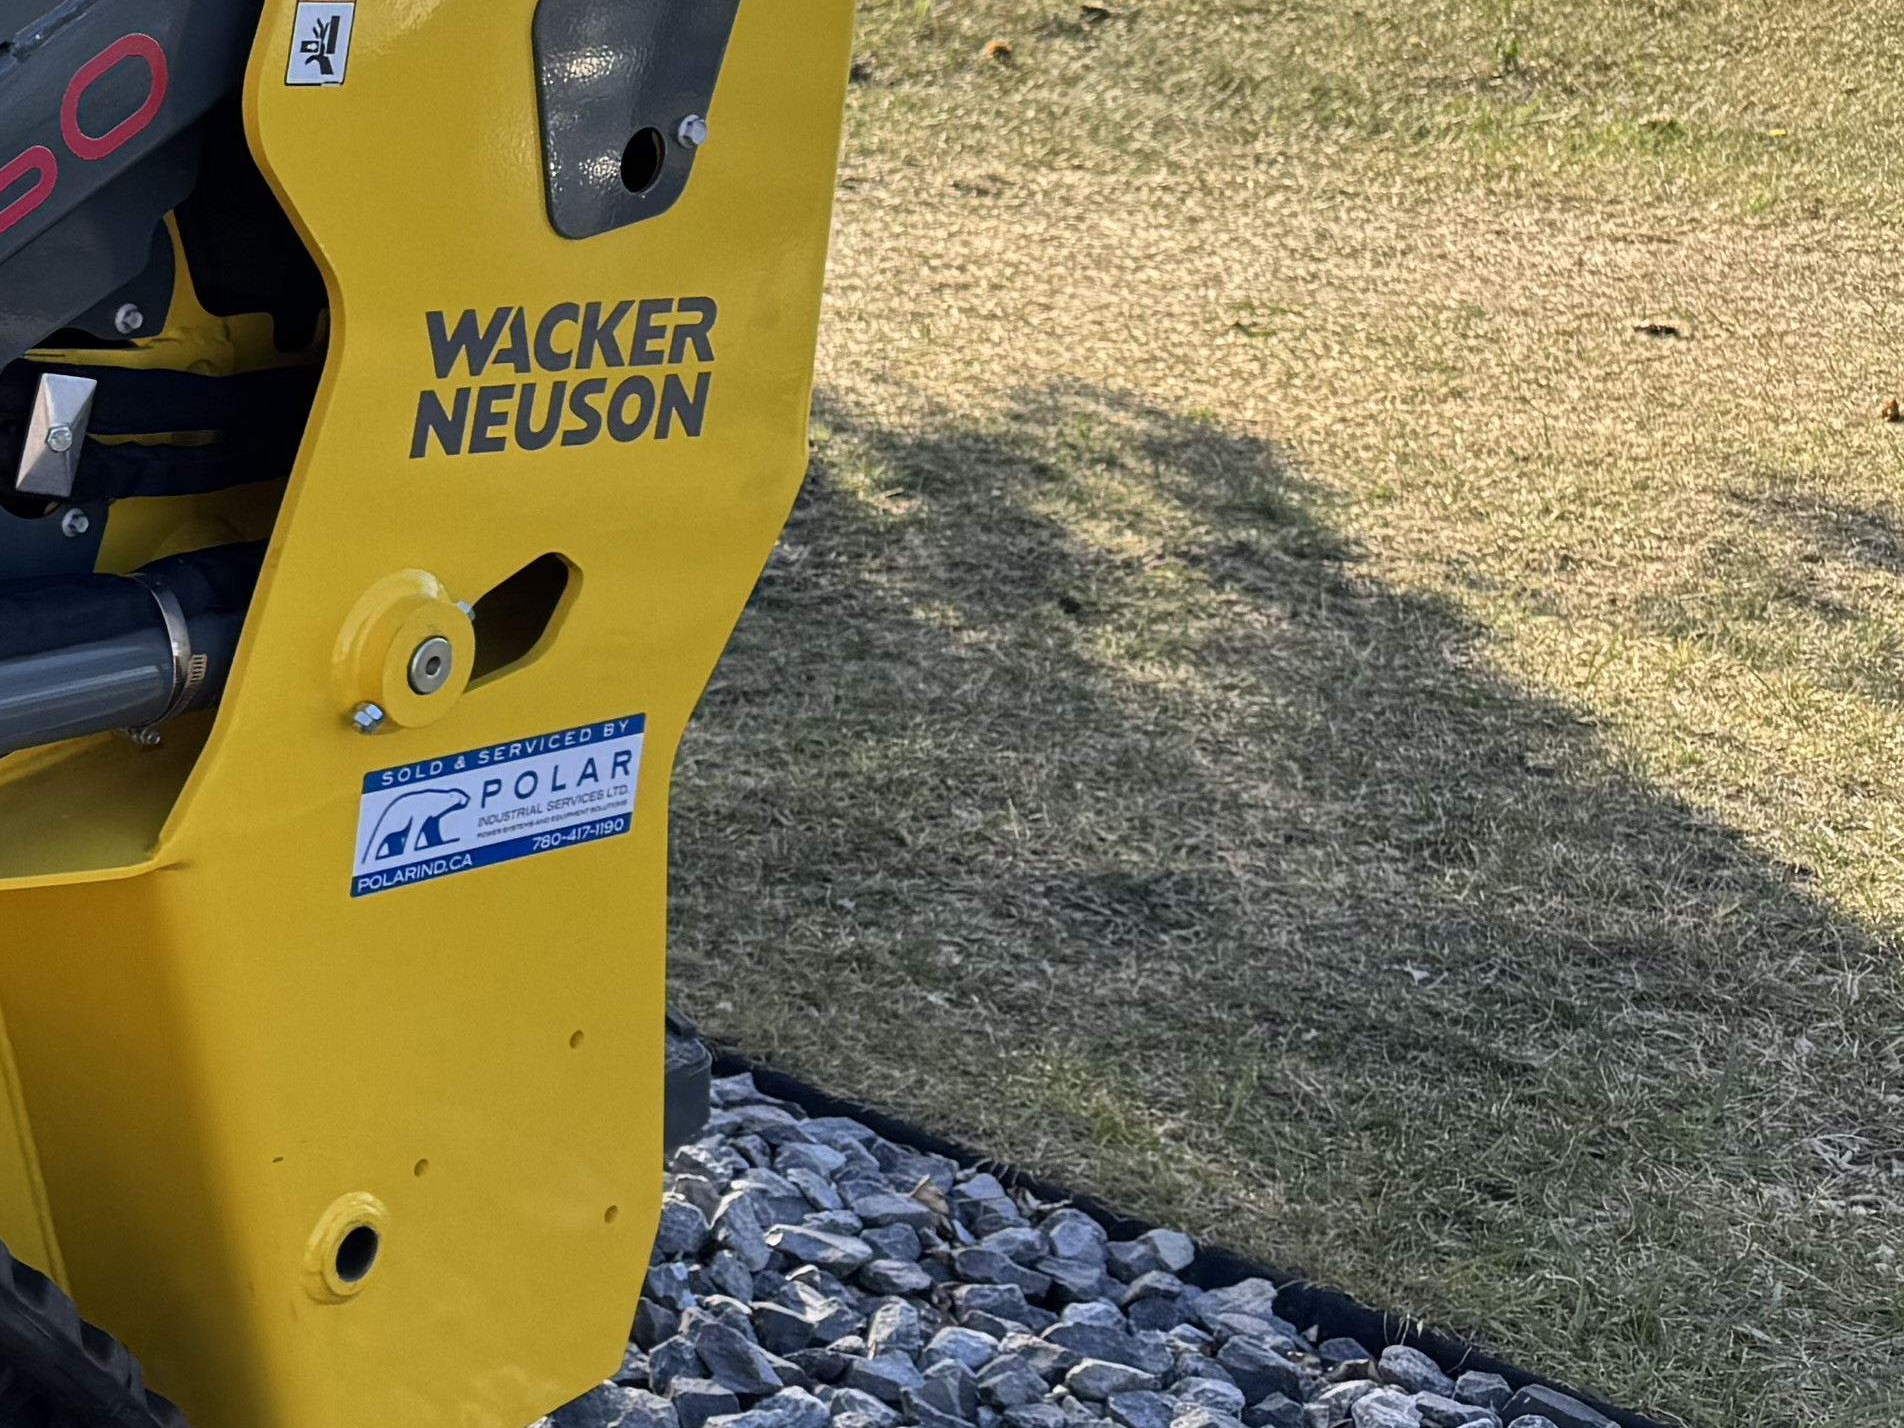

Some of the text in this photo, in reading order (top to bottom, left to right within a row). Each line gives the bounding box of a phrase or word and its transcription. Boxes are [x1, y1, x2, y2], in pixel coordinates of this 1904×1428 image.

[425, 296, 718, 380] WACKER
[409, 371, 712, 459] NEUSON
[381, 719, 629, 786] SOLD & SERVICED BY
[481, 750, 633, 809] POLAR
[478, 784, 629, 827] INDUSTRIAL SERVICES LTD.
[532, 818, 624, 850] 780-417-1190
[357, 854, 473, 893] POLARIND.CA
